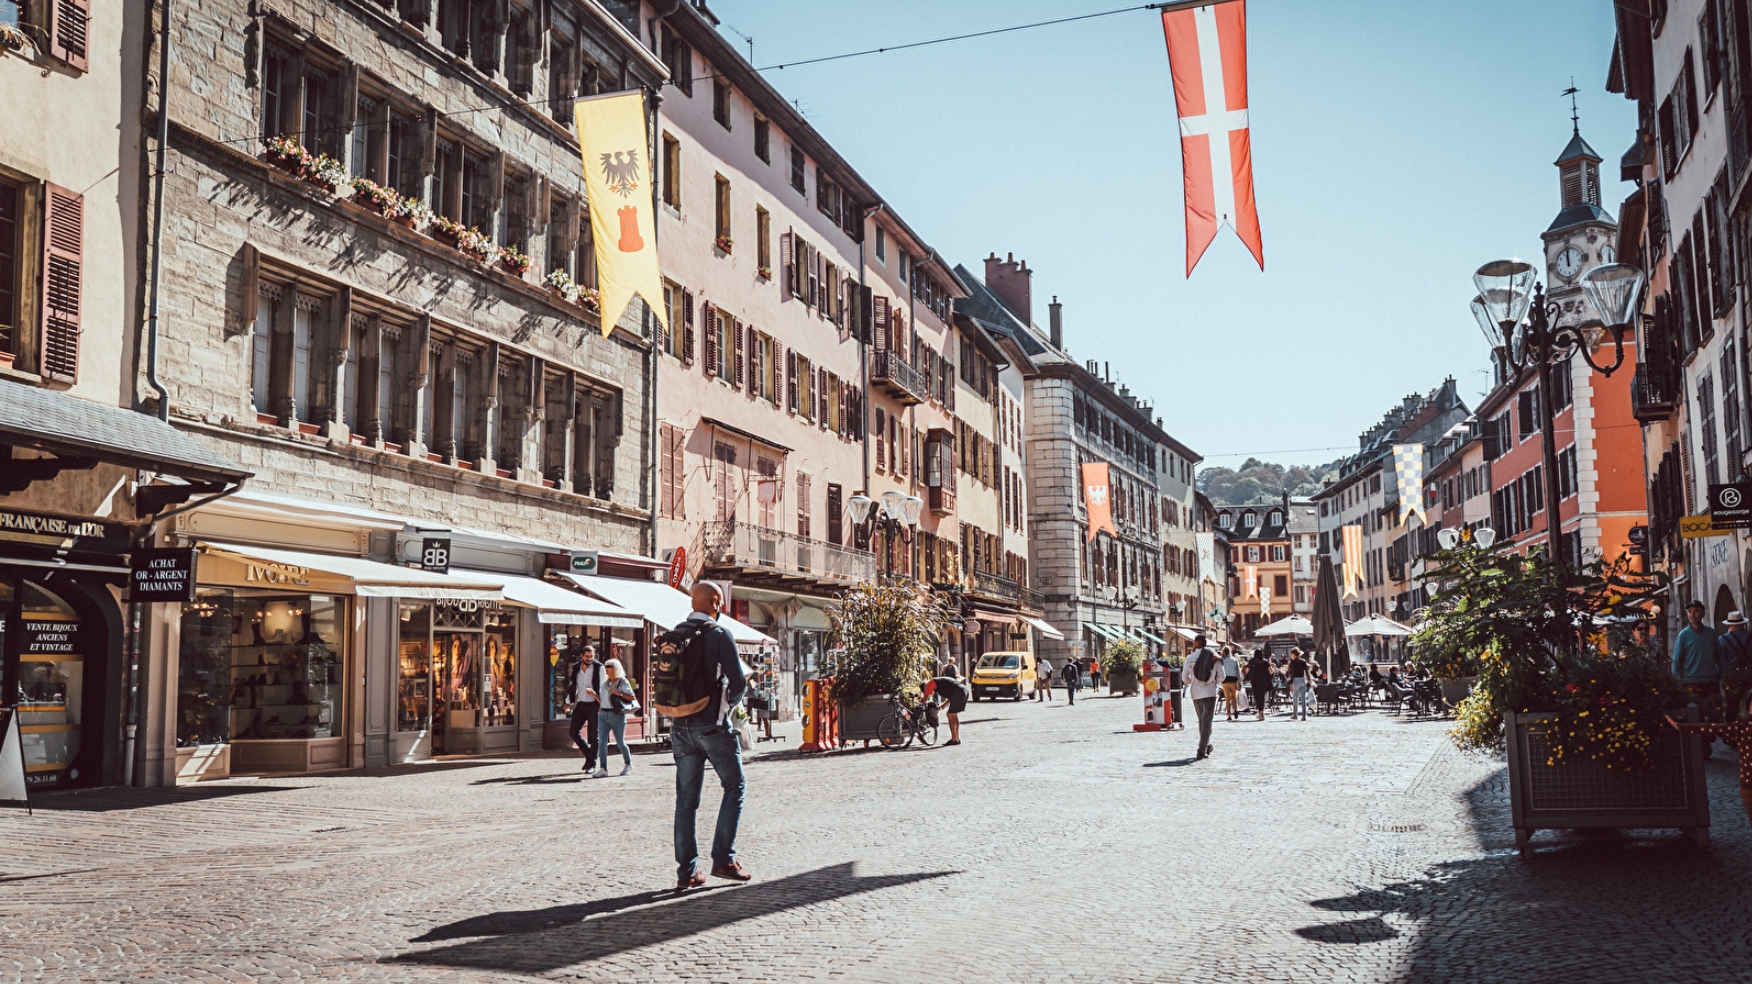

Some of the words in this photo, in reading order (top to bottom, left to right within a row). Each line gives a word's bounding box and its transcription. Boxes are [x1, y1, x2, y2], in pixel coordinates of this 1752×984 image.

[0, 513, 67, 533] FRANÇAISE
[1682, 522, 1712, 532] BOCA
[148, 559, 177, 568] ACHAT
[246, 564, 310, 585] IVOIRE
[672, 556, 681, 583] TABAC
[135, 571, 148, 580] OR
[154, 570, 188, 580] ARGENT
[140, 582, 183, 591] DIAMANTS
[26, 623, 51, 631] VENTE
[52, 624, 78, 632] BIJOUX
[36, 633, 68, 641] ANCIENS
